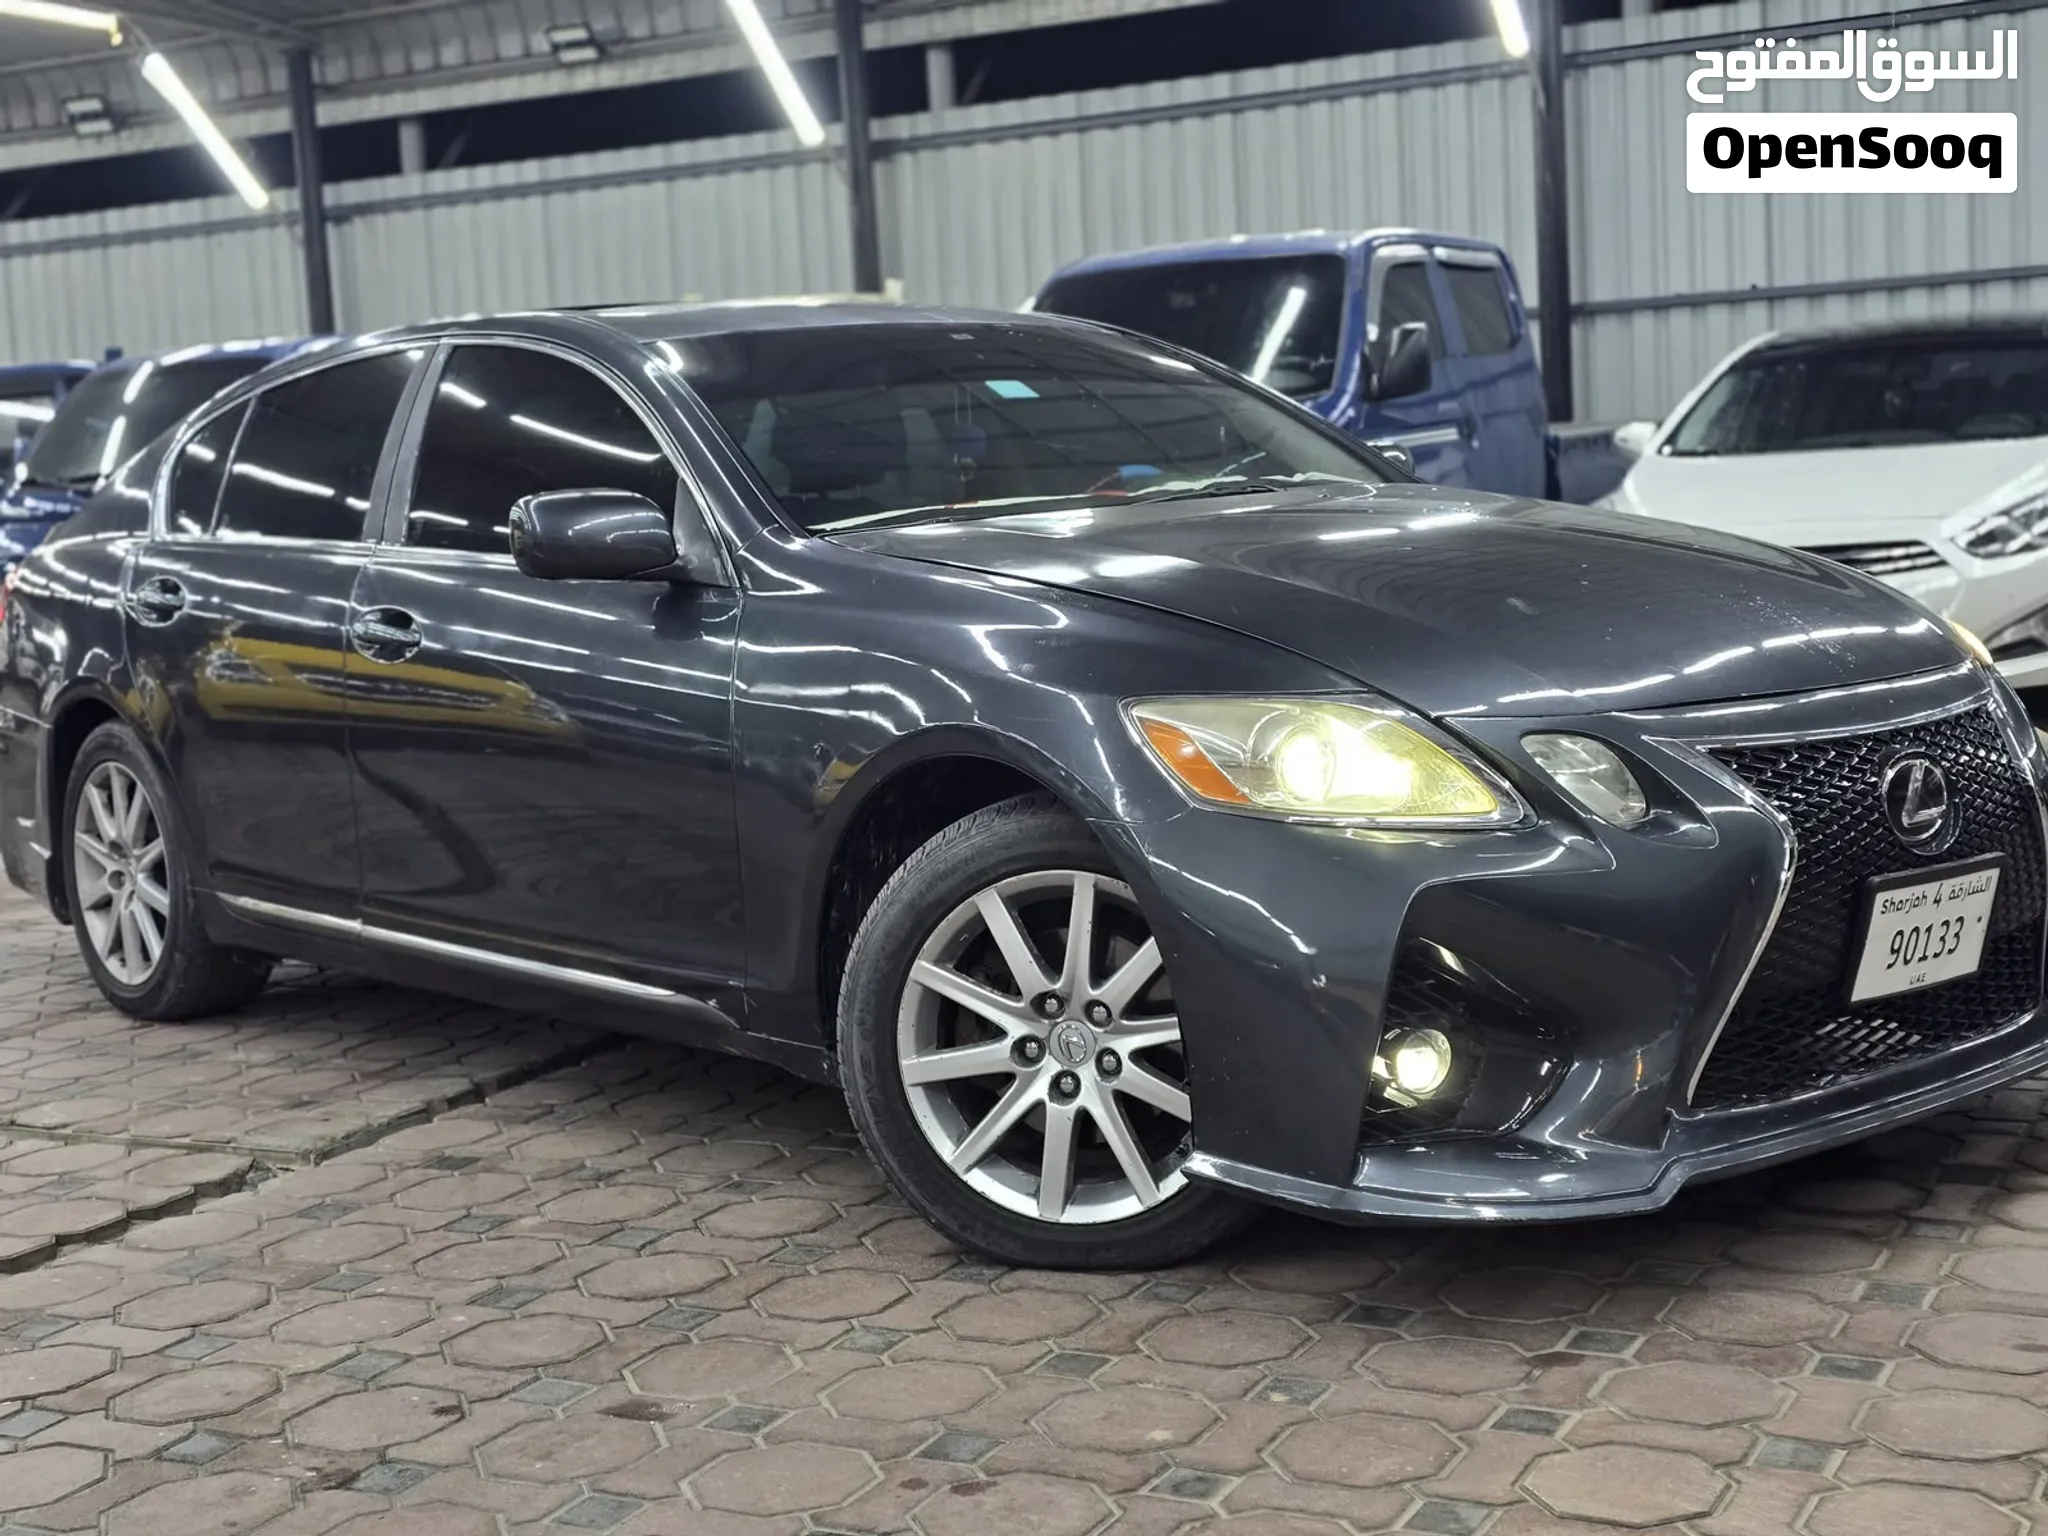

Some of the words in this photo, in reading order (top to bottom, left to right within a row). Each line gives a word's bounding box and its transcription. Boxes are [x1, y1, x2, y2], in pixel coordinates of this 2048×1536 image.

[1880, 890, 1928, 915] Sharjah
[1933, 882, 1944, 909] 4
[1948, 875, 1993, 902] الشارقة
[1885, 915, 1965, 970] 90133
[1909, 972, 1927, 986] UAE
